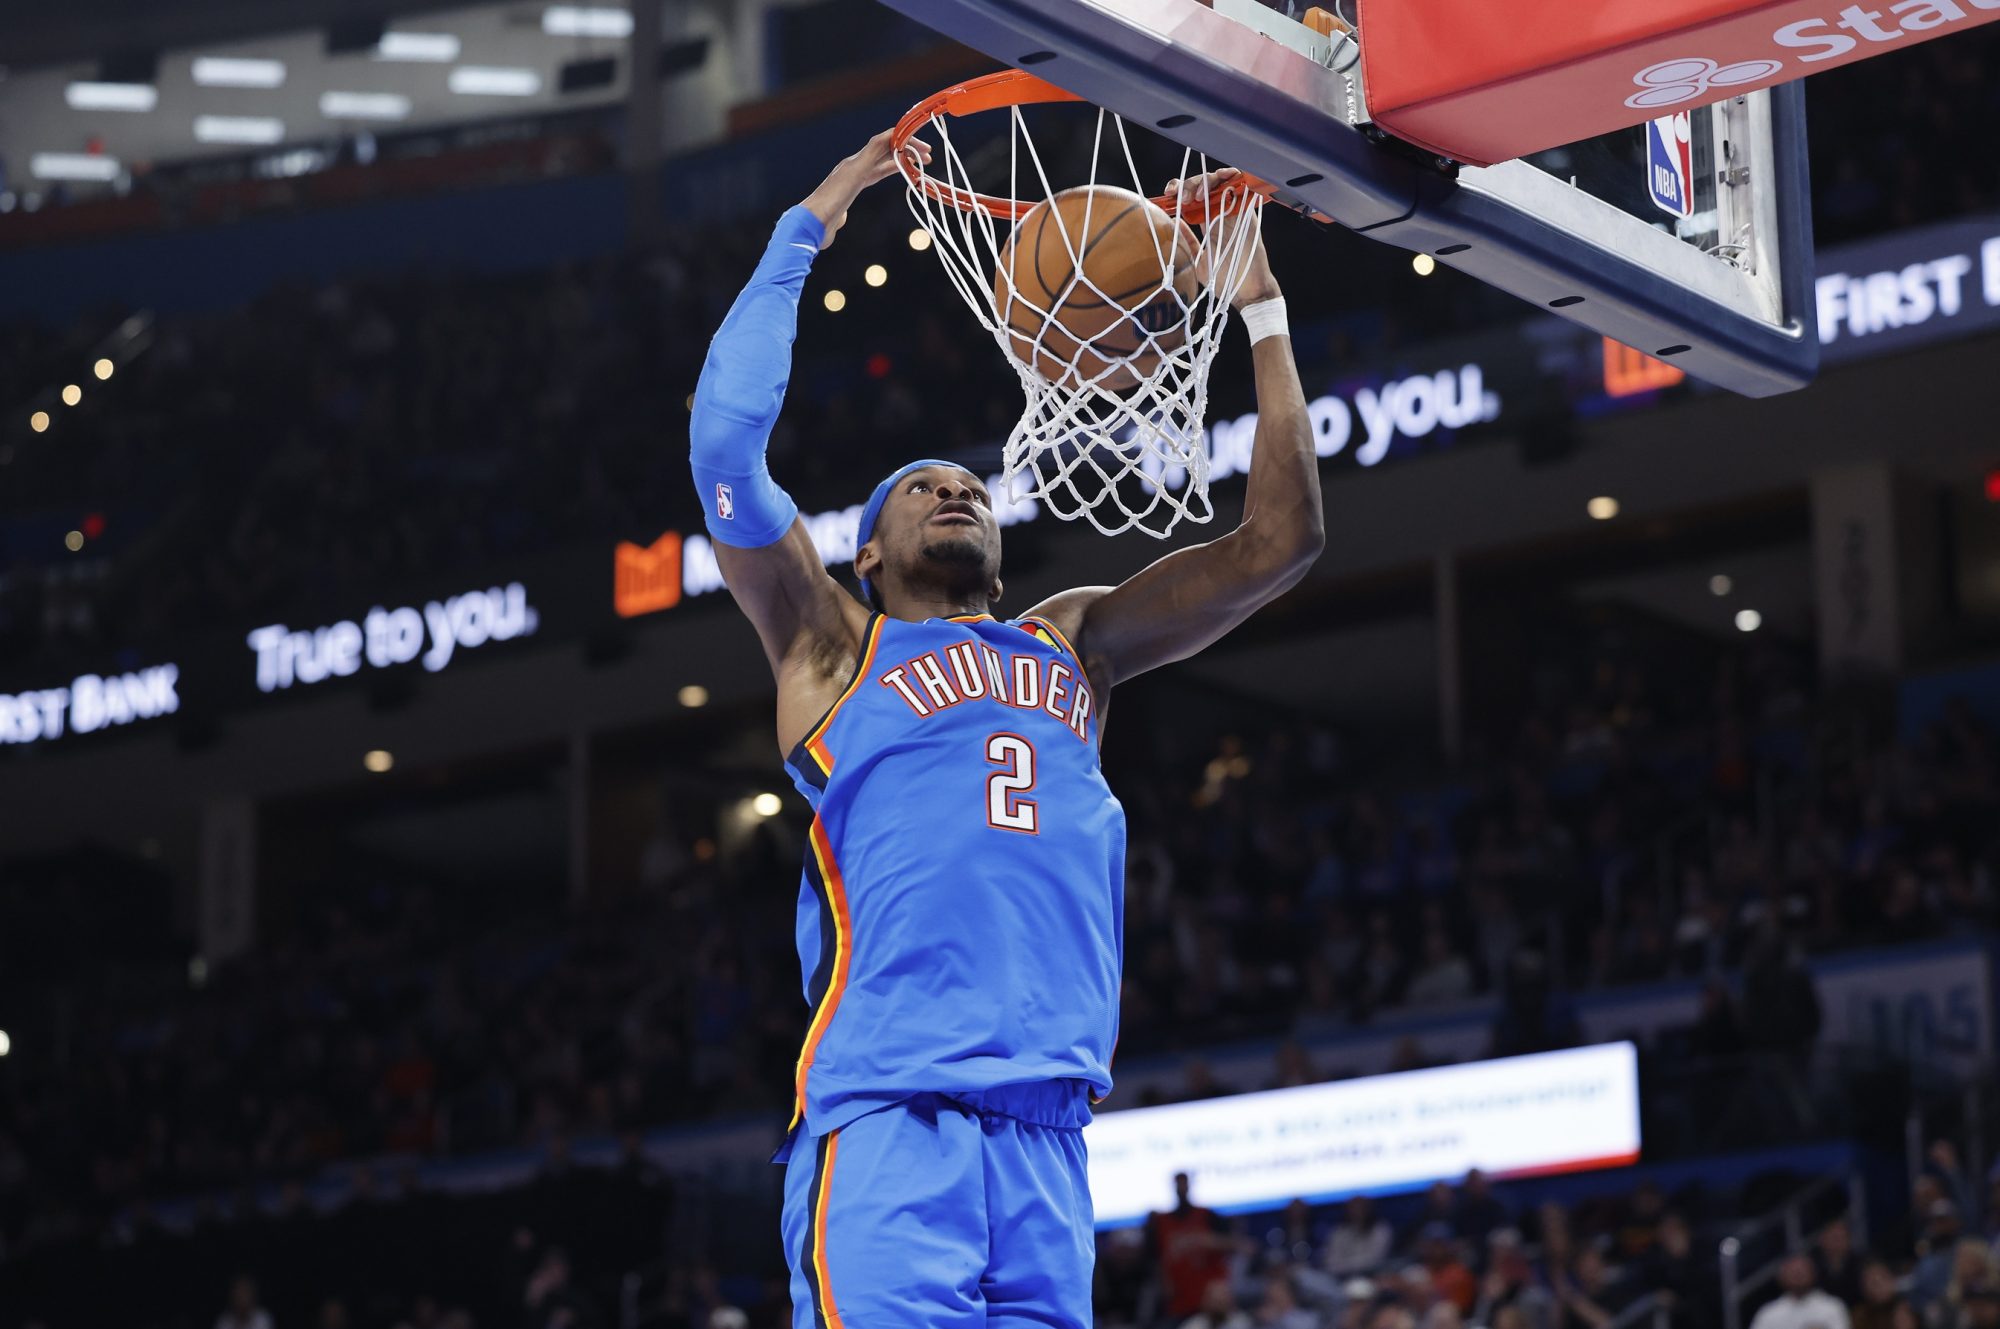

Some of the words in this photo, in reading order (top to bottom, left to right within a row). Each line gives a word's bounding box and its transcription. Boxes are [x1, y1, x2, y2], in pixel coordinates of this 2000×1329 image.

[1773, 0, 2000, 62] Sta
[1655, 164, 1678, 202] NBA
[1354, 362, 1503, 468] you.
[246, 618, 364, 694] True
[364, 604, 424, 669] to
[421, 580, 541, 674] you.
[878, 640, 1093, 745] THUNDER
[984, 731, 1040, 836] 2
